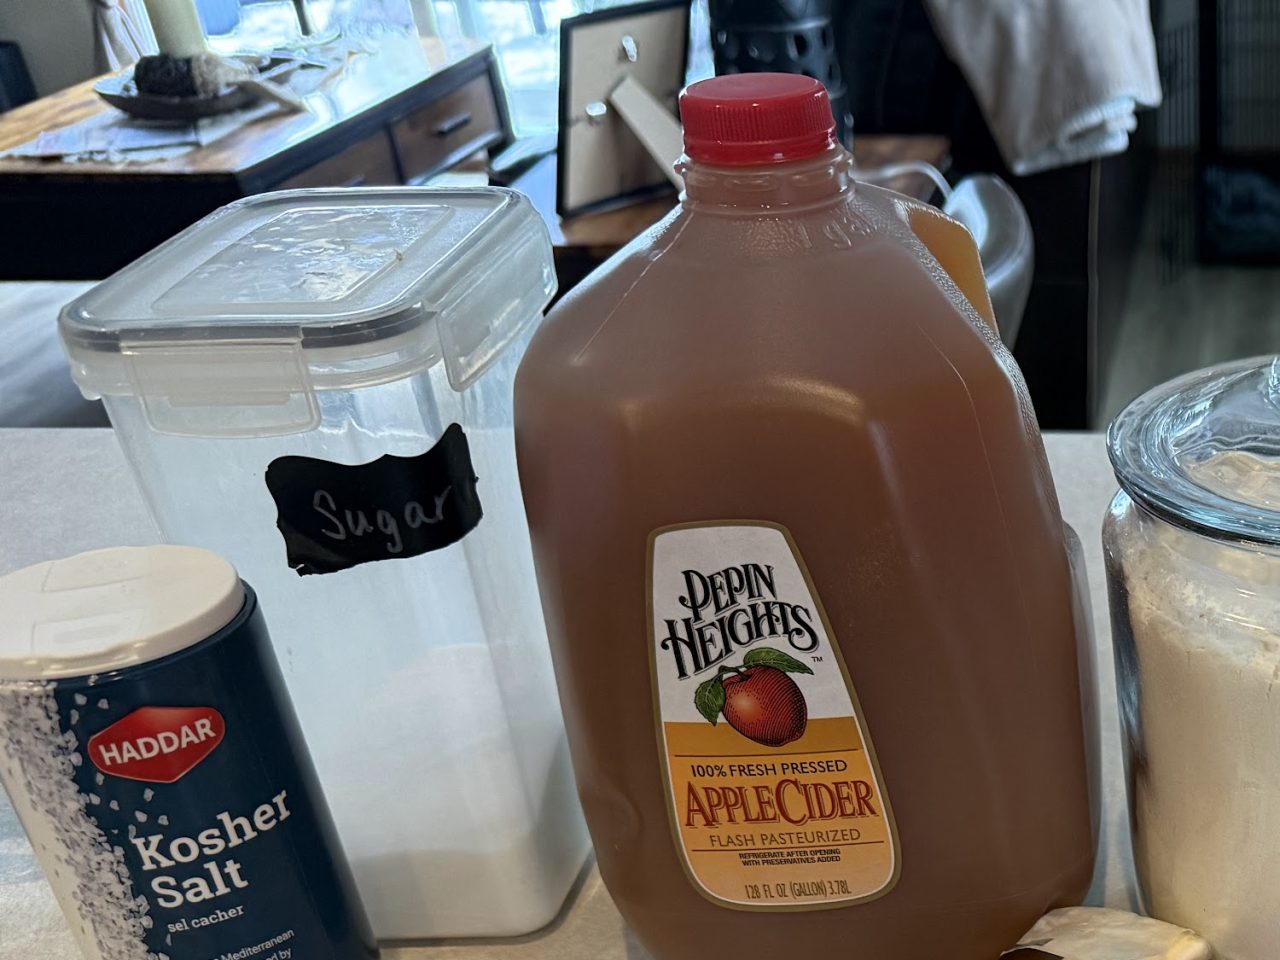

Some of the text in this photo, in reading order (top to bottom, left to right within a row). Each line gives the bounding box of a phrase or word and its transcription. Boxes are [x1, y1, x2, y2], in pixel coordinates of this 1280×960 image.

[313, 485, 452, 554] Sugar
[679, 563, 778, 621] PEPIN
[661, 601, 819, 680] HEIGHTS
[98, 717, 215, 766] HADDAR
[691, 759, 848, 778] 100% FRESH PRESSED
[685, 778, 880, 829] APPLE CIDER
[130, 788, 292, 871] Kosher
[709, 828, 861, 848] FLASH PASTEURIZED
[739, 848, 841, 860] REFRIGERATE AFTER OPENING
[761, 857, 816, 866] PRESERVATIVES
[817, 855, 841, 863] ADDED
[149, 857, 249, 909] Salt
[744, 879, 852, 900] 128 FL OZ (GALLON) 3.78L
[167, 904, 244, 933] sel cacher
[279, 948, 292, 960] by
